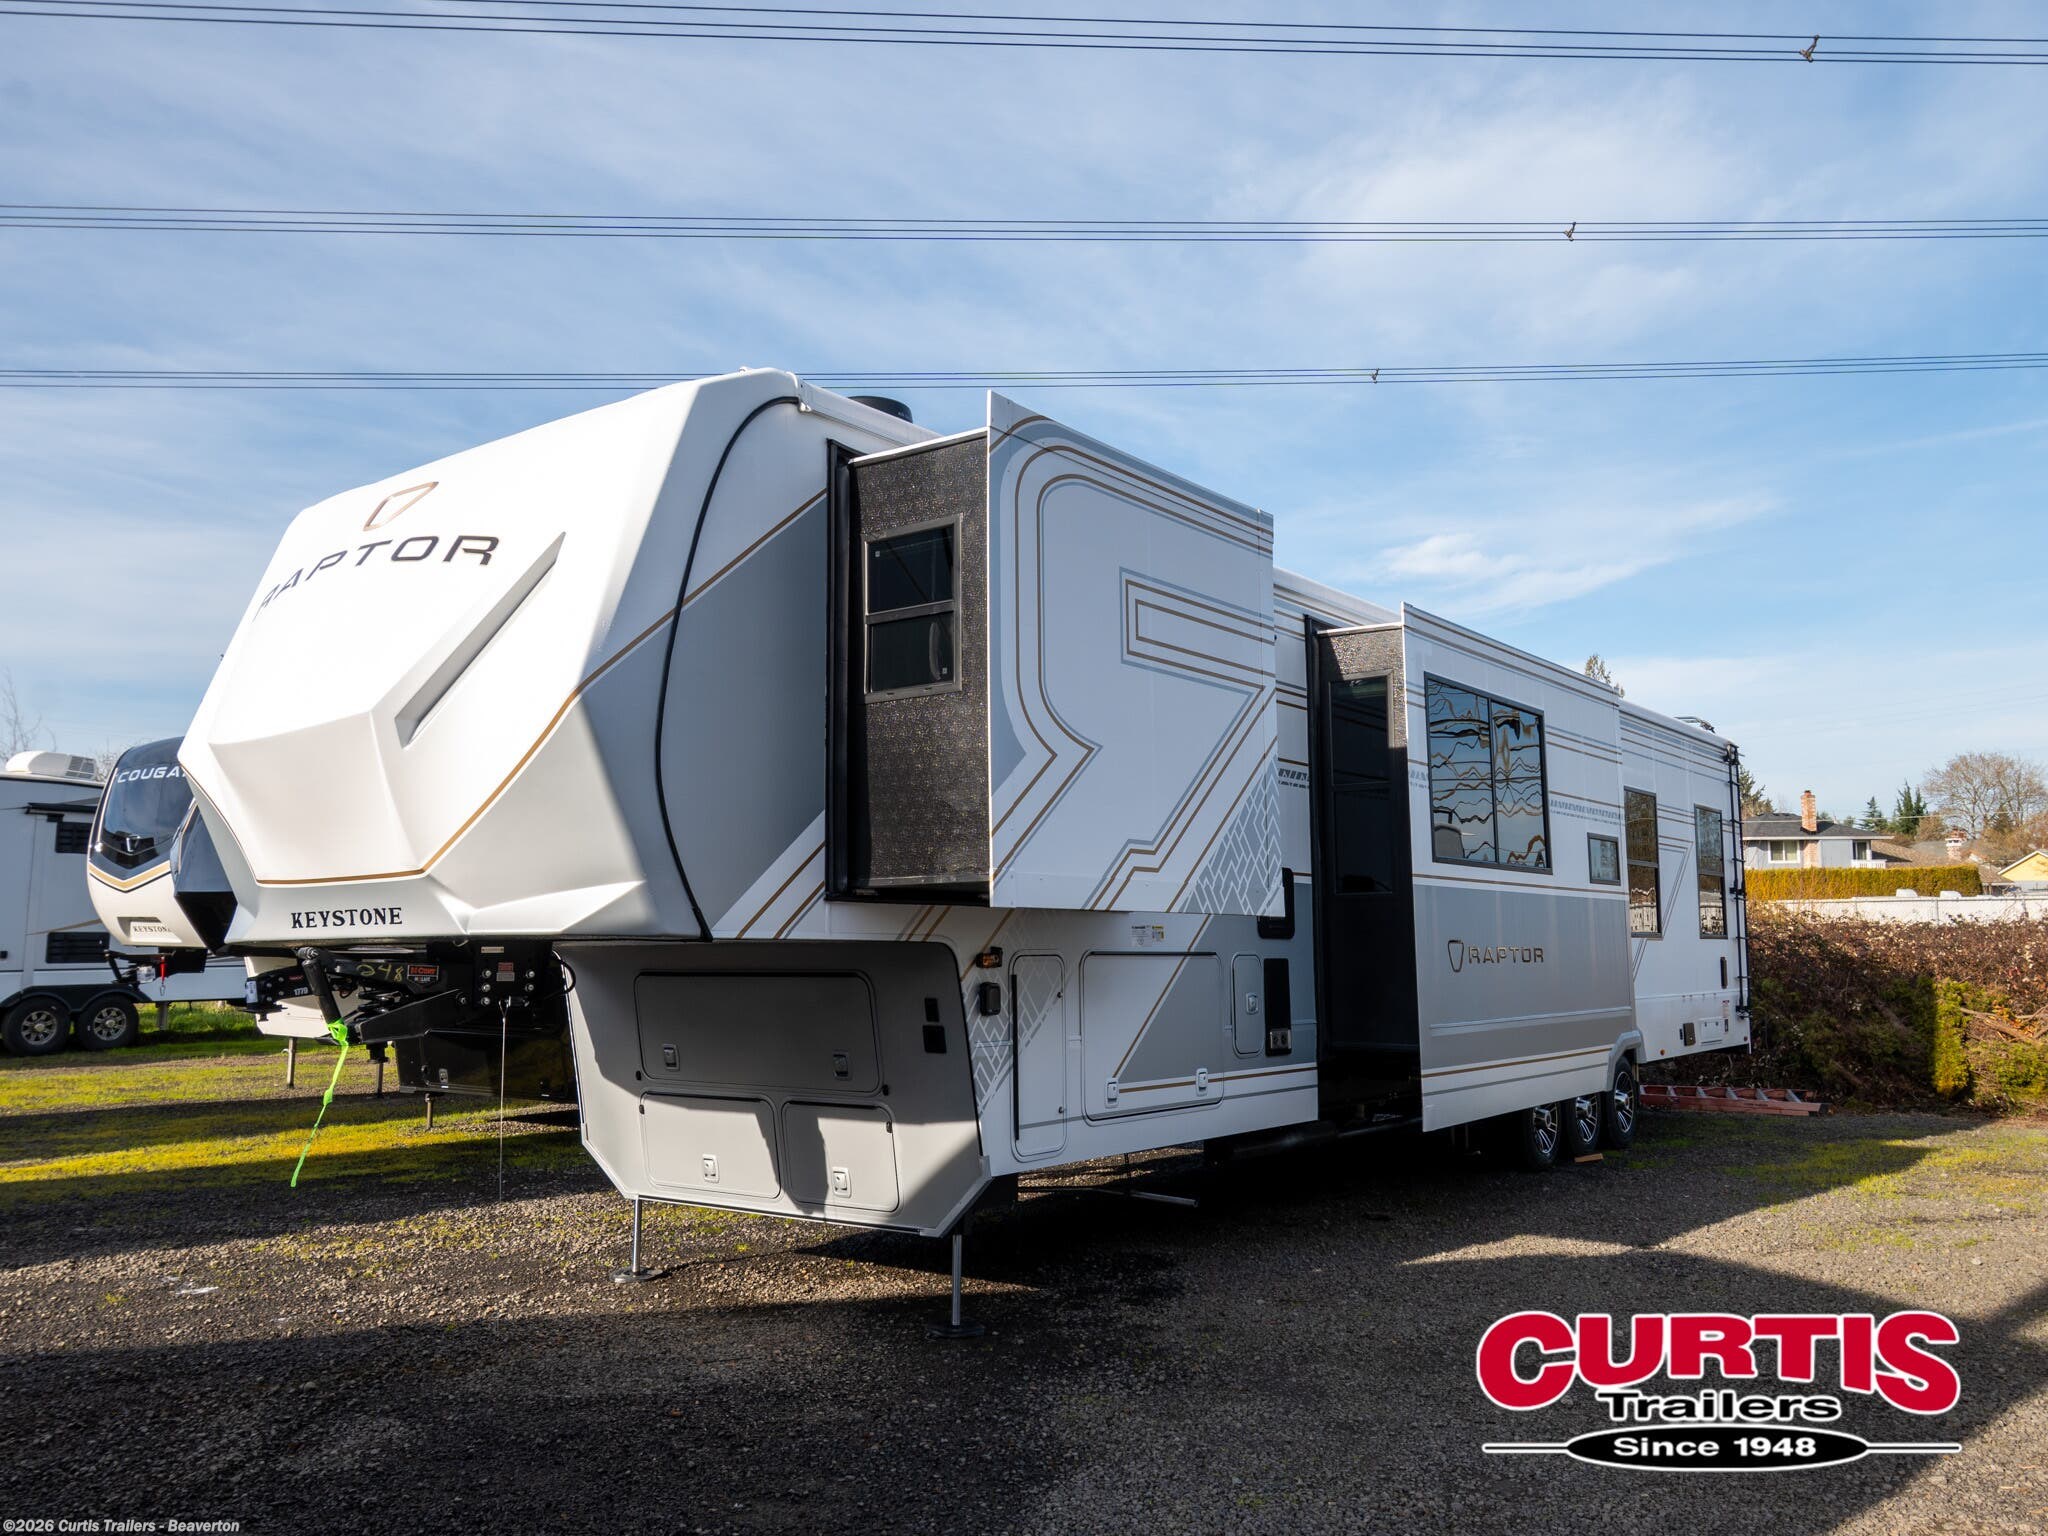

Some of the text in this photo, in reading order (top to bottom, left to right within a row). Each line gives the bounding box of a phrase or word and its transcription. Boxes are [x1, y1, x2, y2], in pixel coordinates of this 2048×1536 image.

[252, 535, 500, 624] RAPTOR
[116, 765, 186, 784] COUGA
[291, 907, 403, 929] KEYSTONE
[132, 925, 171, 933] KEYSTON
[1468, 946, 1544, 964] RAPTOR
